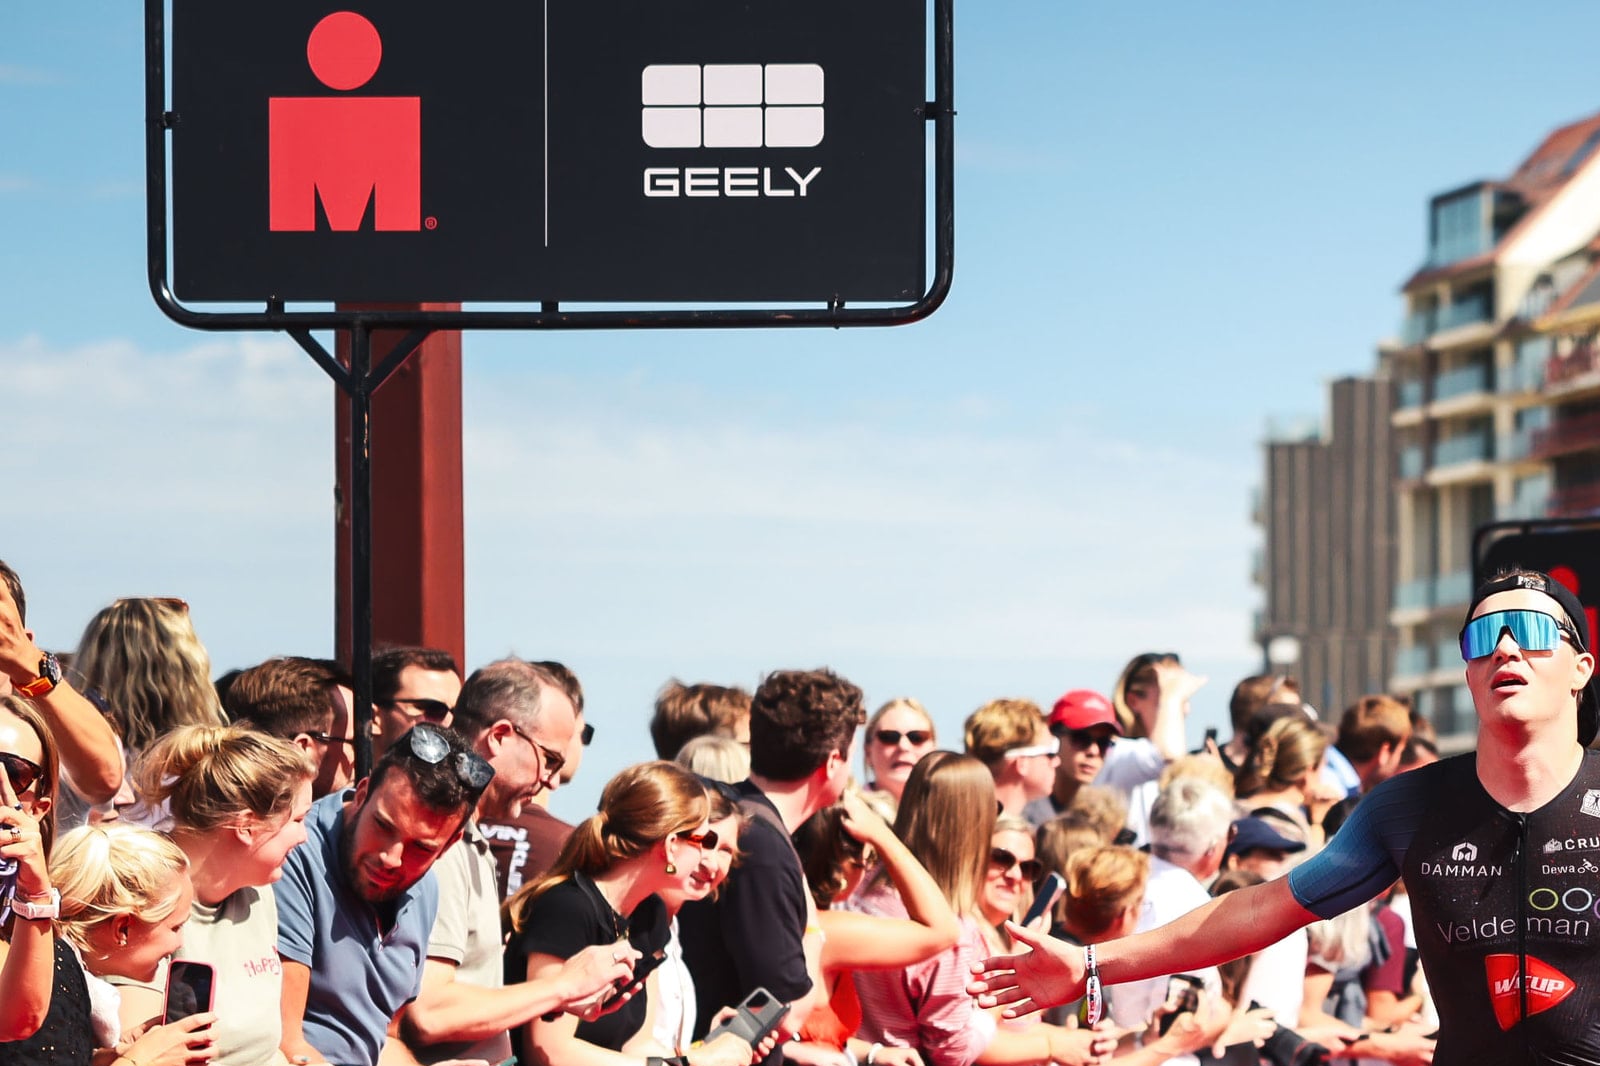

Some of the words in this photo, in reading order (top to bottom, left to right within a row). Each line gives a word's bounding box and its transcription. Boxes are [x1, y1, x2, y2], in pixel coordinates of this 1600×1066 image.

[643, 167, 822, 197] GEELY
[1421, 862, 1502, 877] DAMMAN
[1541, 864, 1576, 875] Dewa
